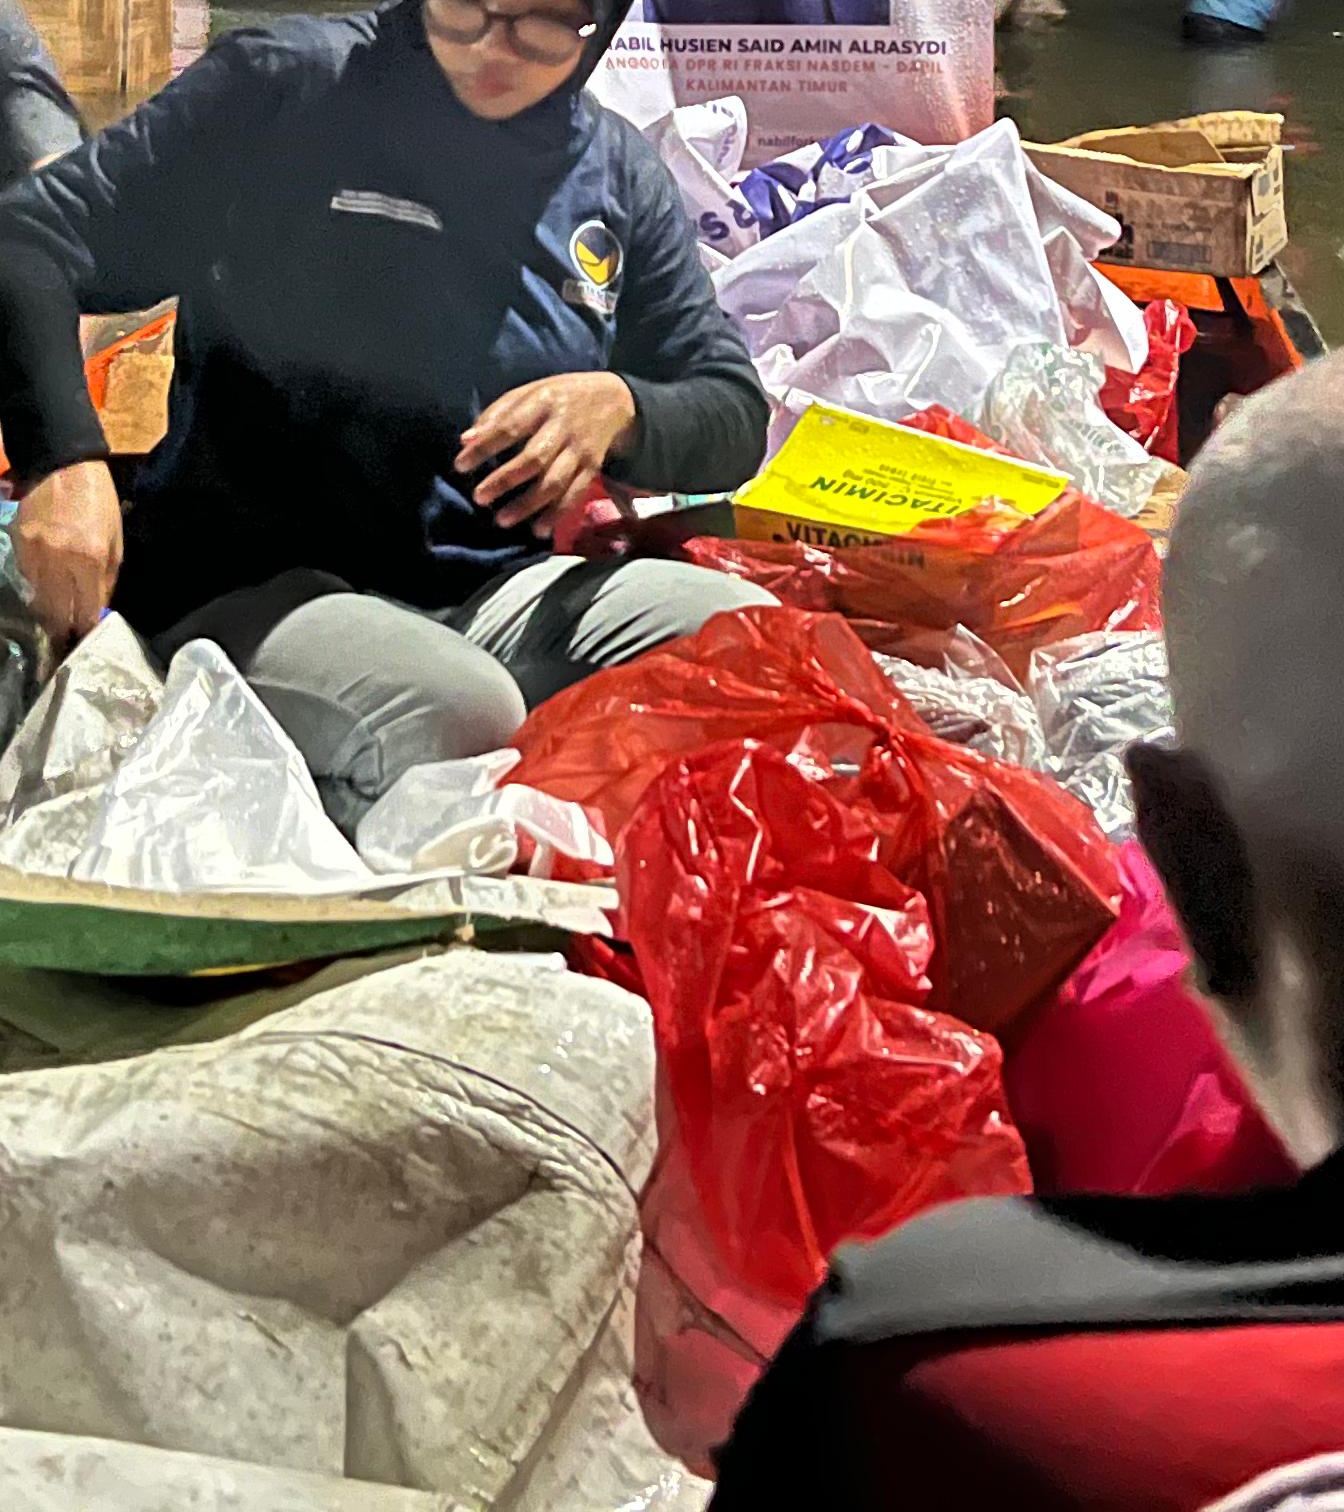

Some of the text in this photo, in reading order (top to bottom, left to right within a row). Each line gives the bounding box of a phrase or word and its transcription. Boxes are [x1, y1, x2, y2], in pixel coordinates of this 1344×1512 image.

[608, 36, 947, 55] ABIL HUSIEN SAID AMIN ALRASYDI
[686, 58, 717, 71] DPR
[723, 58, 738, 71] RI
[744, 59, 802, 72] FRAKSI
[807, 60, 877, 73] NASDEM
[686, 79, 848, 93] KALIMANTAN TIMUR
[808, 476, 960, 515] ITACIMIN
